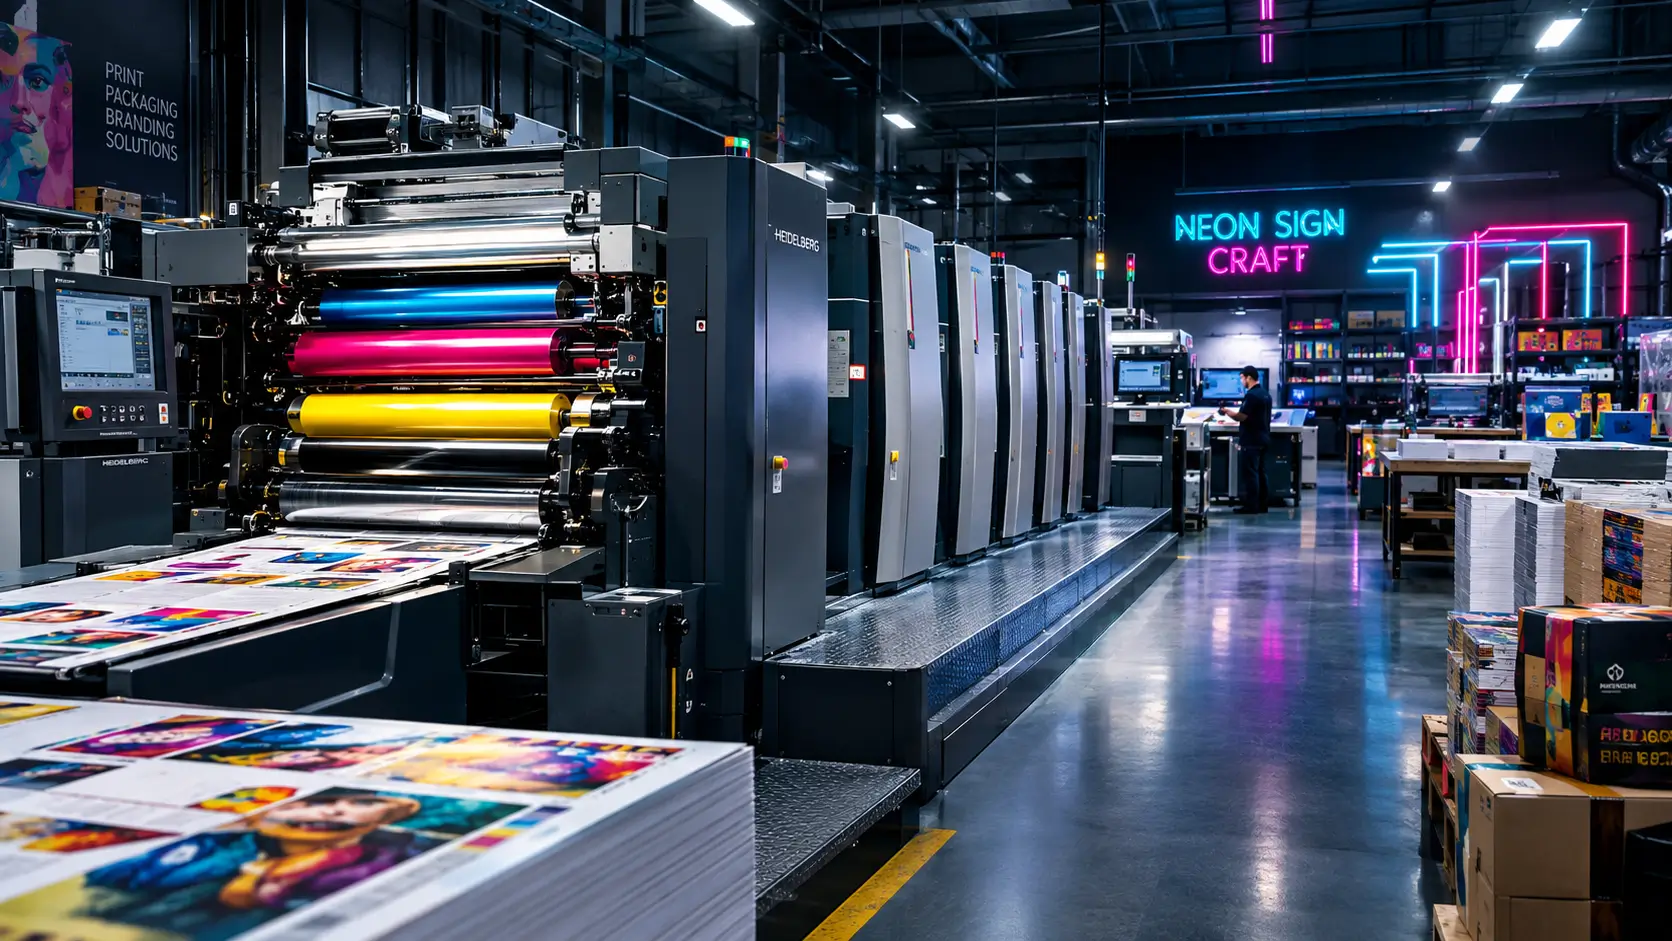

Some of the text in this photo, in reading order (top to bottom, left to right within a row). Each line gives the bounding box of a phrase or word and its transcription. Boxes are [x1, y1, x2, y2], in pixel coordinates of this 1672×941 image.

[106, 61, 144, 87] PRINT
[106, 84, 178, 119] PACKAGING
[106, 107, 175, 139] BRANDING
[106, 130, 178, 161] SOLUTIONS
[774, 228, 820, 252] HEIDELBERG
[1175, 208, 1345, 241] NEON SIGN
[1208, 244, 1309, 274] CRAFT
